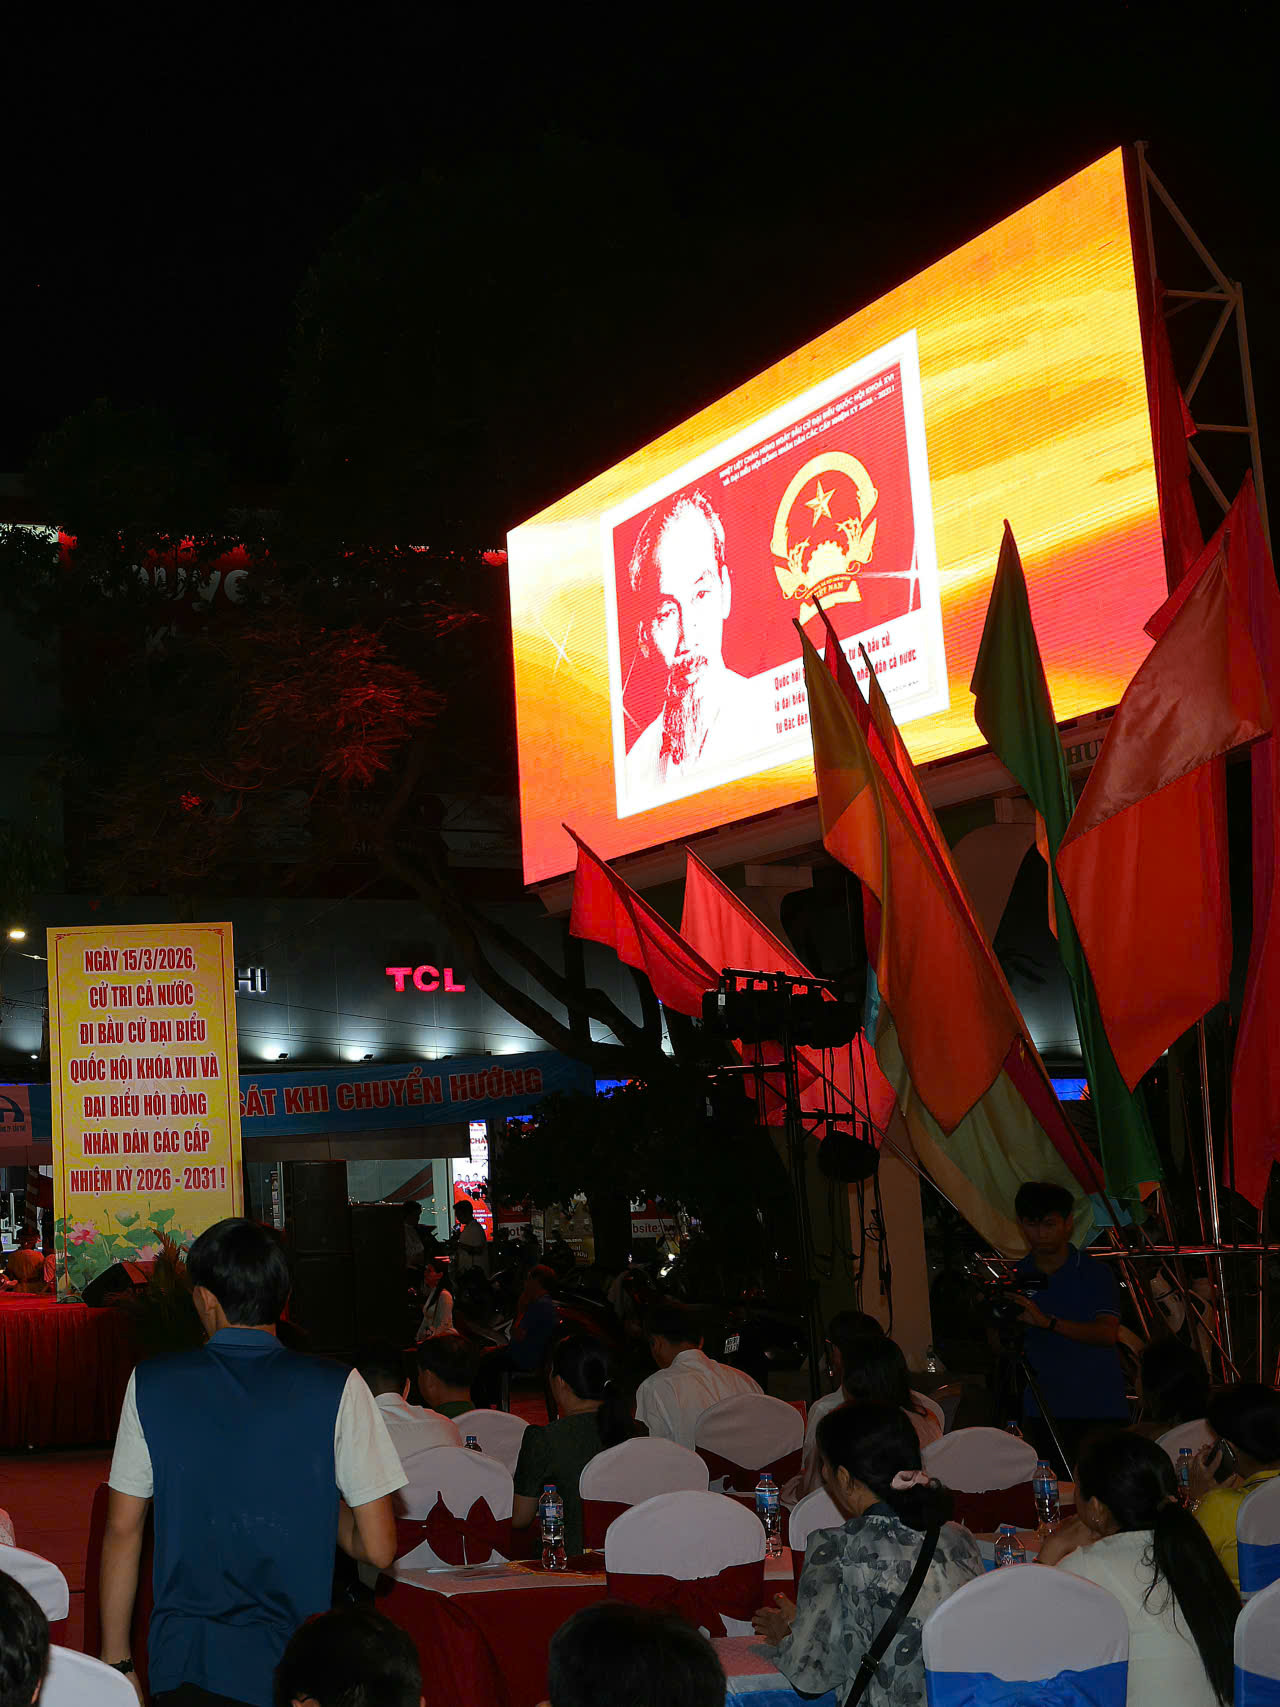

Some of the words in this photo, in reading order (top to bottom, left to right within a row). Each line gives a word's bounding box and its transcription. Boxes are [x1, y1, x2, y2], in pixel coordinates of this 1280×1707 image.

[85, 946, 119, 972] NGÀY
[122, 947, 196, 971] 15/3/2026,
[89, 982, 109, 1009] CỬ
[111, 986, 133, 1007] TRI
[136, 980, 155, 1007] CẢ
[158, 980, 194, 1006] NƯỚC
[385, 965, 466, 993] TCL
[80, 1023, 93, 1045] ĐI
[99, 1015, 124, 1044] BẦU
[128, 1016, 147, 1042] CỬ
[150, 1020, 171, 1046] ĐẠI
[176, 1012, 206, 1041] BIỂU
[70, 1052, 106, 1083] QUỐC
[110, 1055, 133, 1085] HỘI
[137, 1053, 171, 1080] KHÓA
[175, 1056, 197, 1078] XVI
[200, 1052, 219, 1078] VÀ
[284, 1085, 329, 1115] KHI
[336, 1067, 443, 1110] CHUYỂN
[449, 1065, 543, 1102] HƯỚNG
[70, 1166, 112, 1196] NHIỆM
[116, 1165, 133, 1191] KỲ
[137, 1169, 171, 1191] 2026
